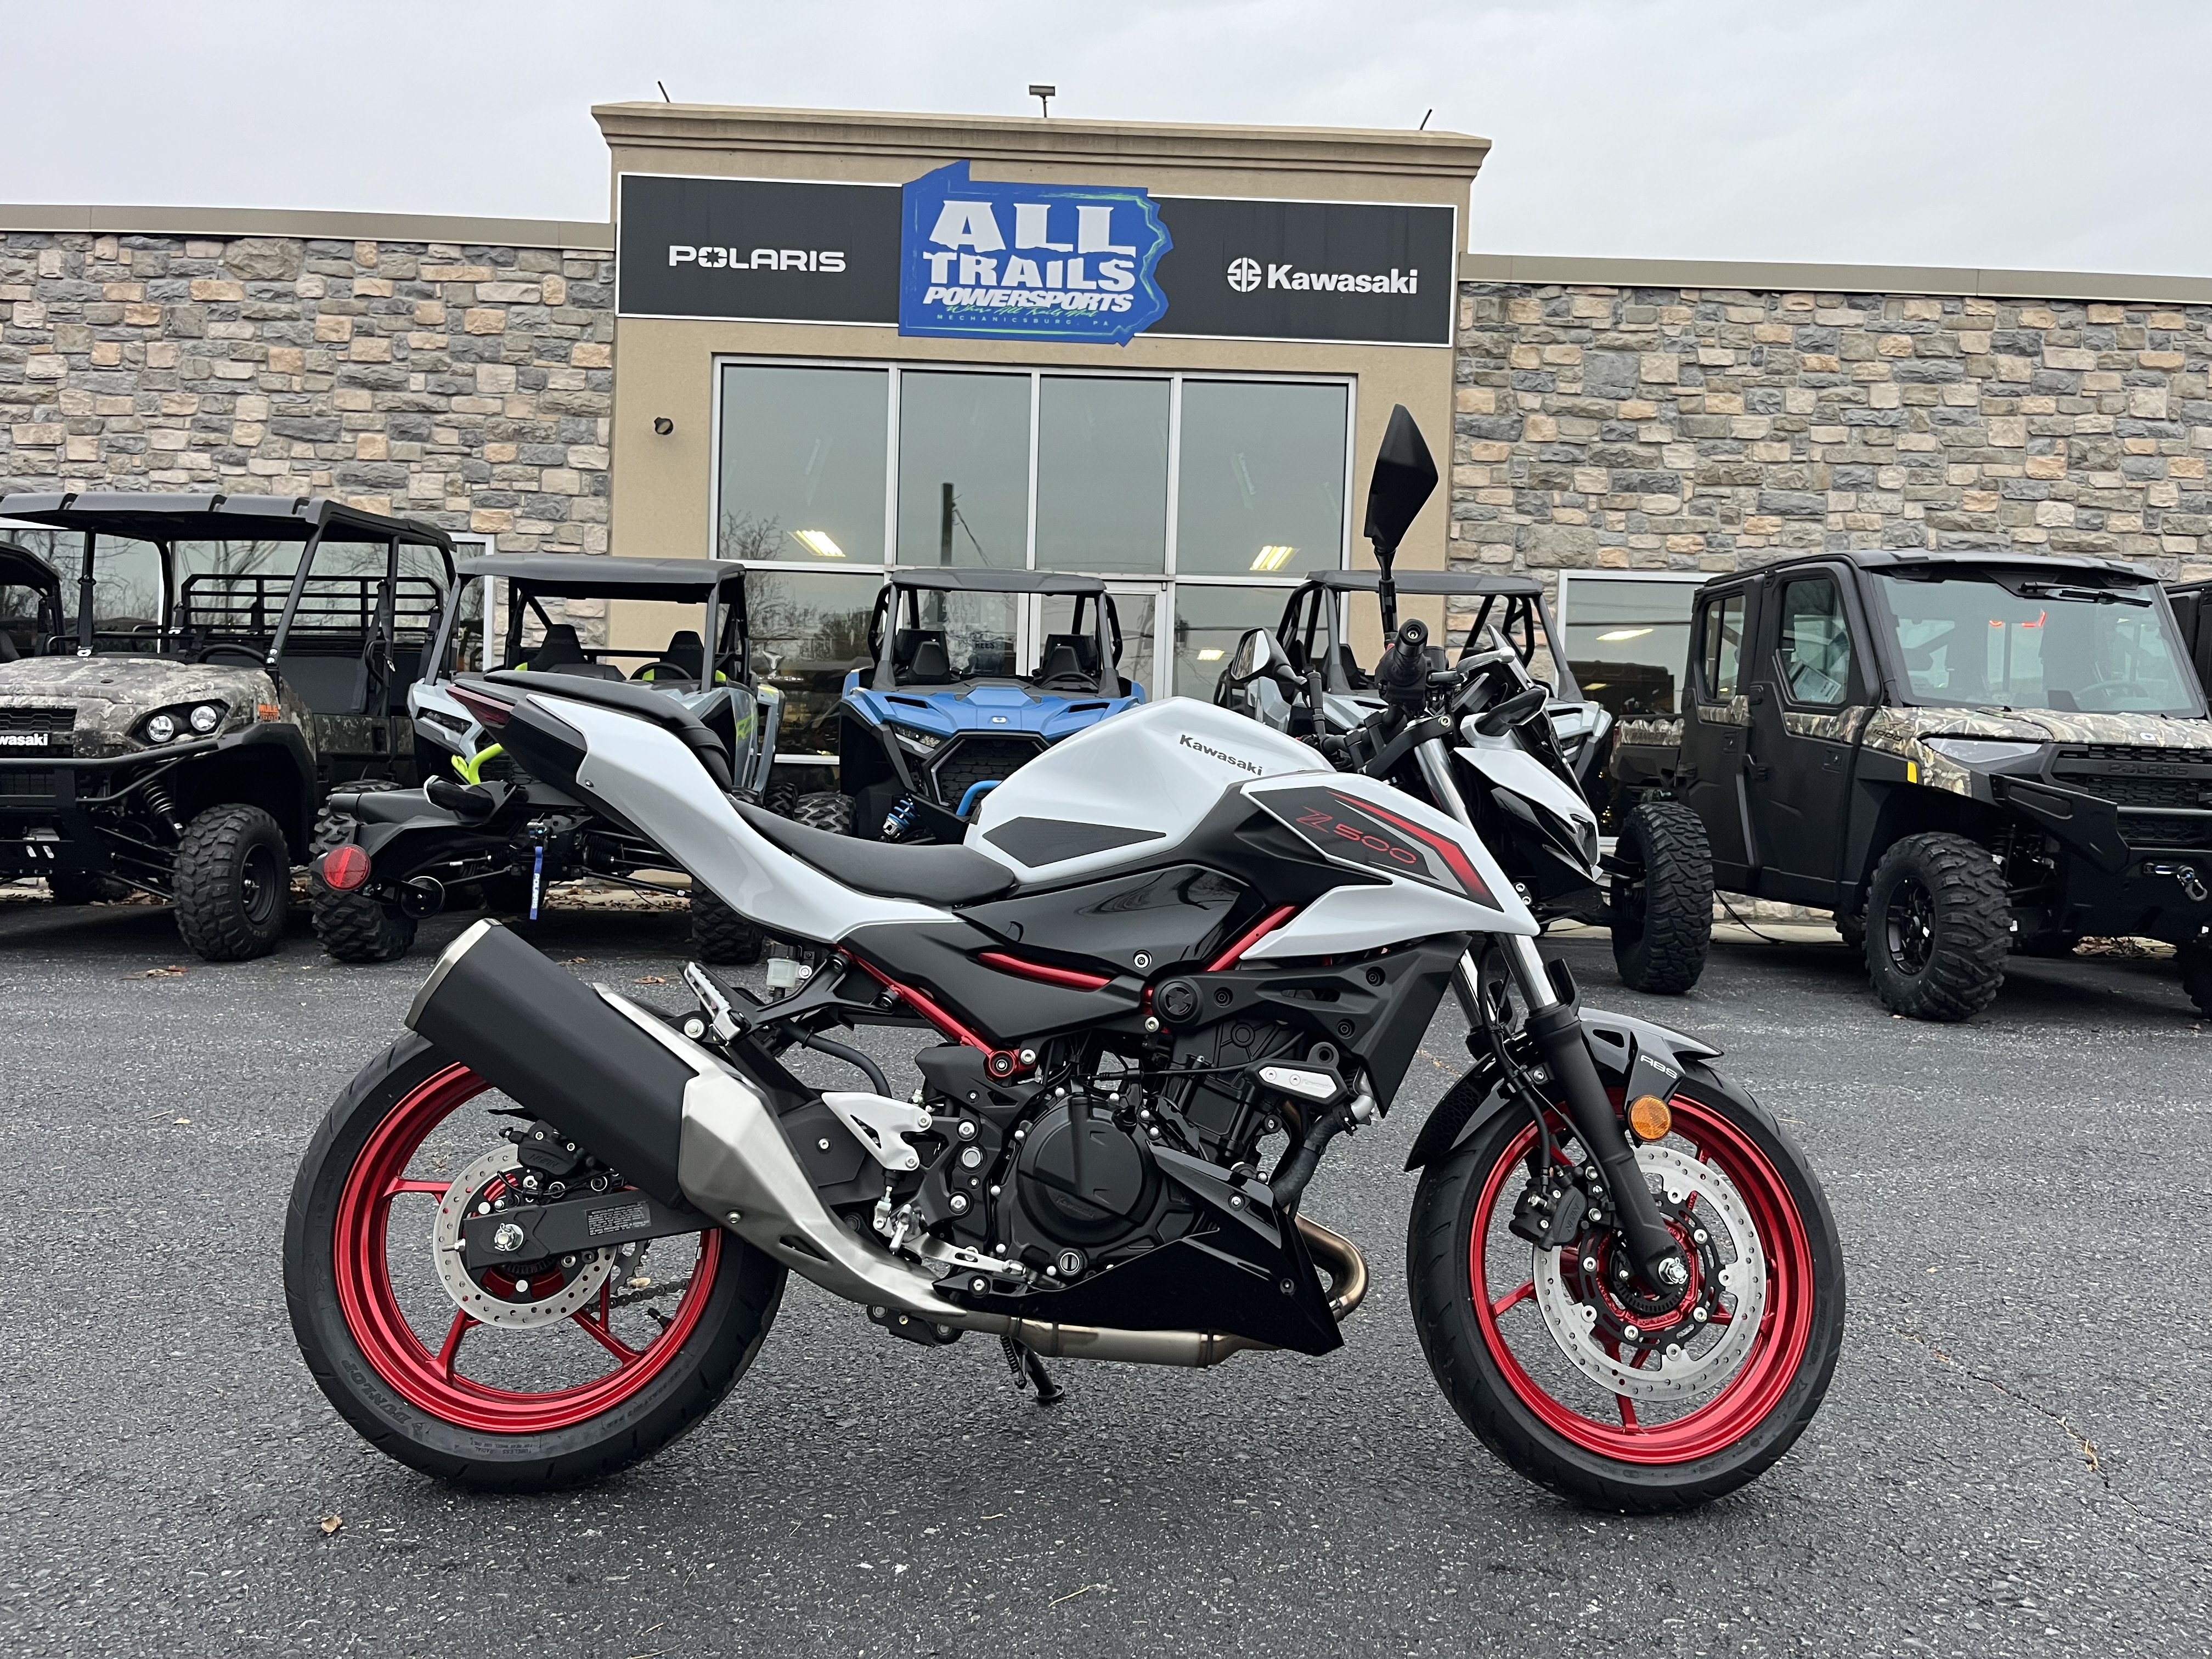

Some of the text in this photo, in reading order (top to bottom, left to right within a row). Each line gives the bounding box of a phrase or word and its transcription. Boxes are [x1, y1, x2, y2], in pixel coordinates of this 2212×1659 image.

[929, 200, 1136, 258] ALL
[669, 245, 847, 273] POLARIS
[923, 251, 1136, 291] TRAILS
[1267, 263, 1418, 294] Kawasaki
[922, 286, 1134, 312] POWERSPORTS
[993, 306, 1024, 315] All
[1872, 729, 1903, 742] 1000
[1180, 734, 1263, 776] Kawasaki
[2108, 763, 2188, 777] POLARIS
[532, 873, 540, 909] POLARIS
[1640, 1054, 1678, 1080] ABS
[341, 1360, 411, 1424] DUNLOP
